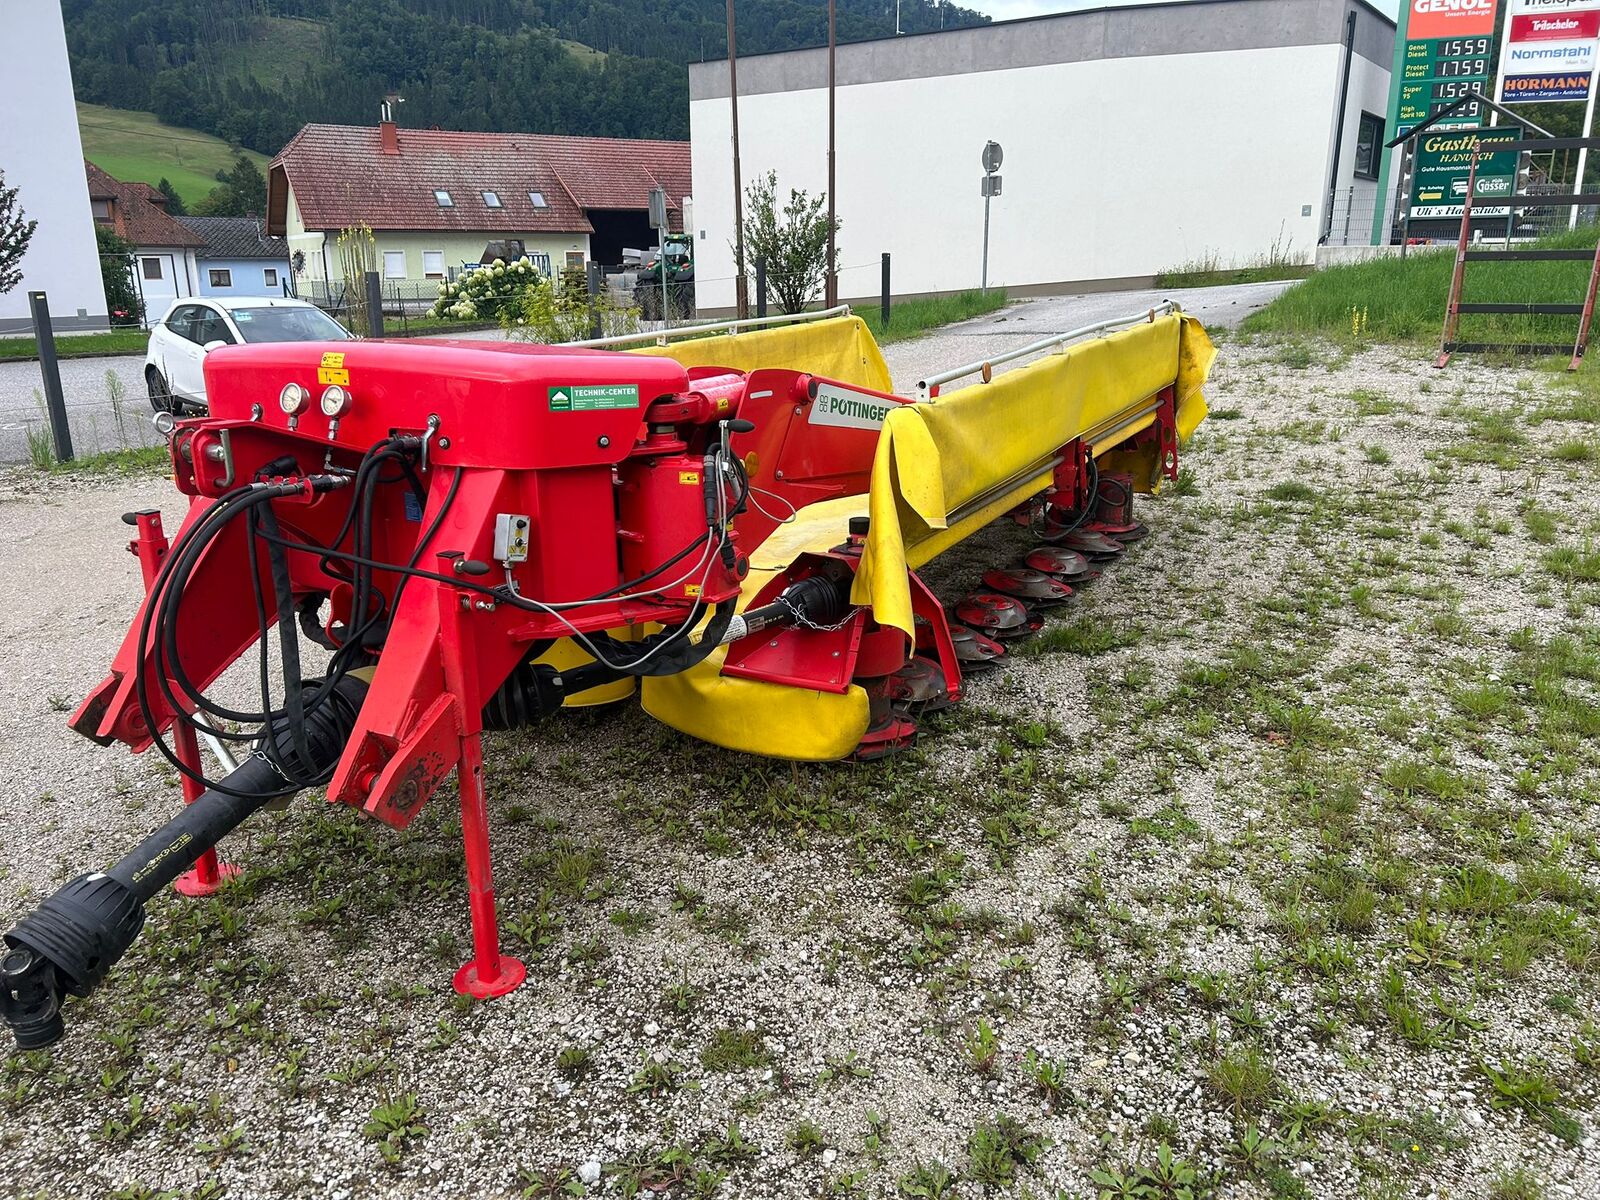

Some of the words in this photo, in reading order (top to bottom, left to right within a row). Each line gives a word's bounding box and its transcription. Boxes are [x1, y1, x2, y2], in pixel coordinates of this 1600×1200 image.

[1414, 0, 1492, 13] GENOL
[1511, 46, 1592, 59] Normstahl
[1504, 76, 1590, 90] HÖRMANN
[1403, 86, 1422, 94] Super
[1476, 178, 1510, 193] Gösser
[574, 387, 636, 397] TECHNIK-CENTER
